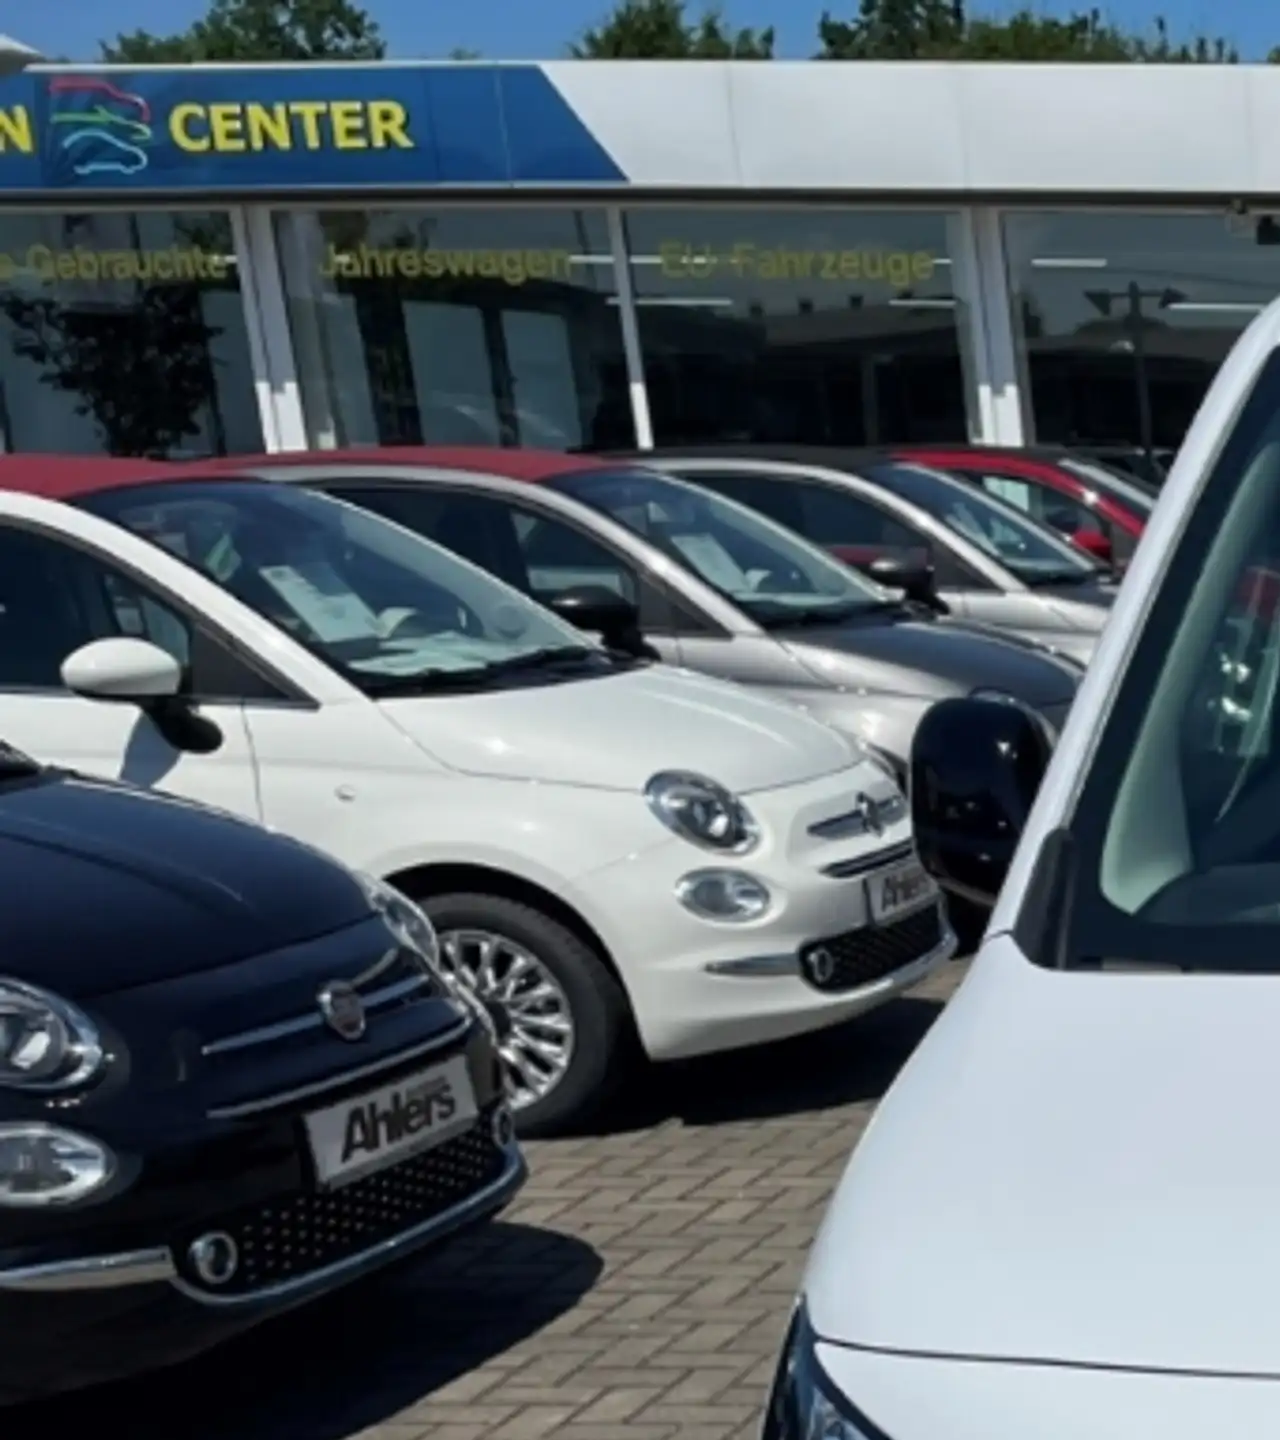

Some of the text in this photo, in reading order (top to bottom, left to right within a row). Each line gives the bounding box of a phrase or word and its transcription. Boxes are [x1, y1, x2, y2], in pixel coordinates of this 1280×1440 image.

[168, 99, 415, 153] CENTER
[317, 241, 572, 287] Jahreswagen
[340, 1081, 456, 1164] Ahlers
